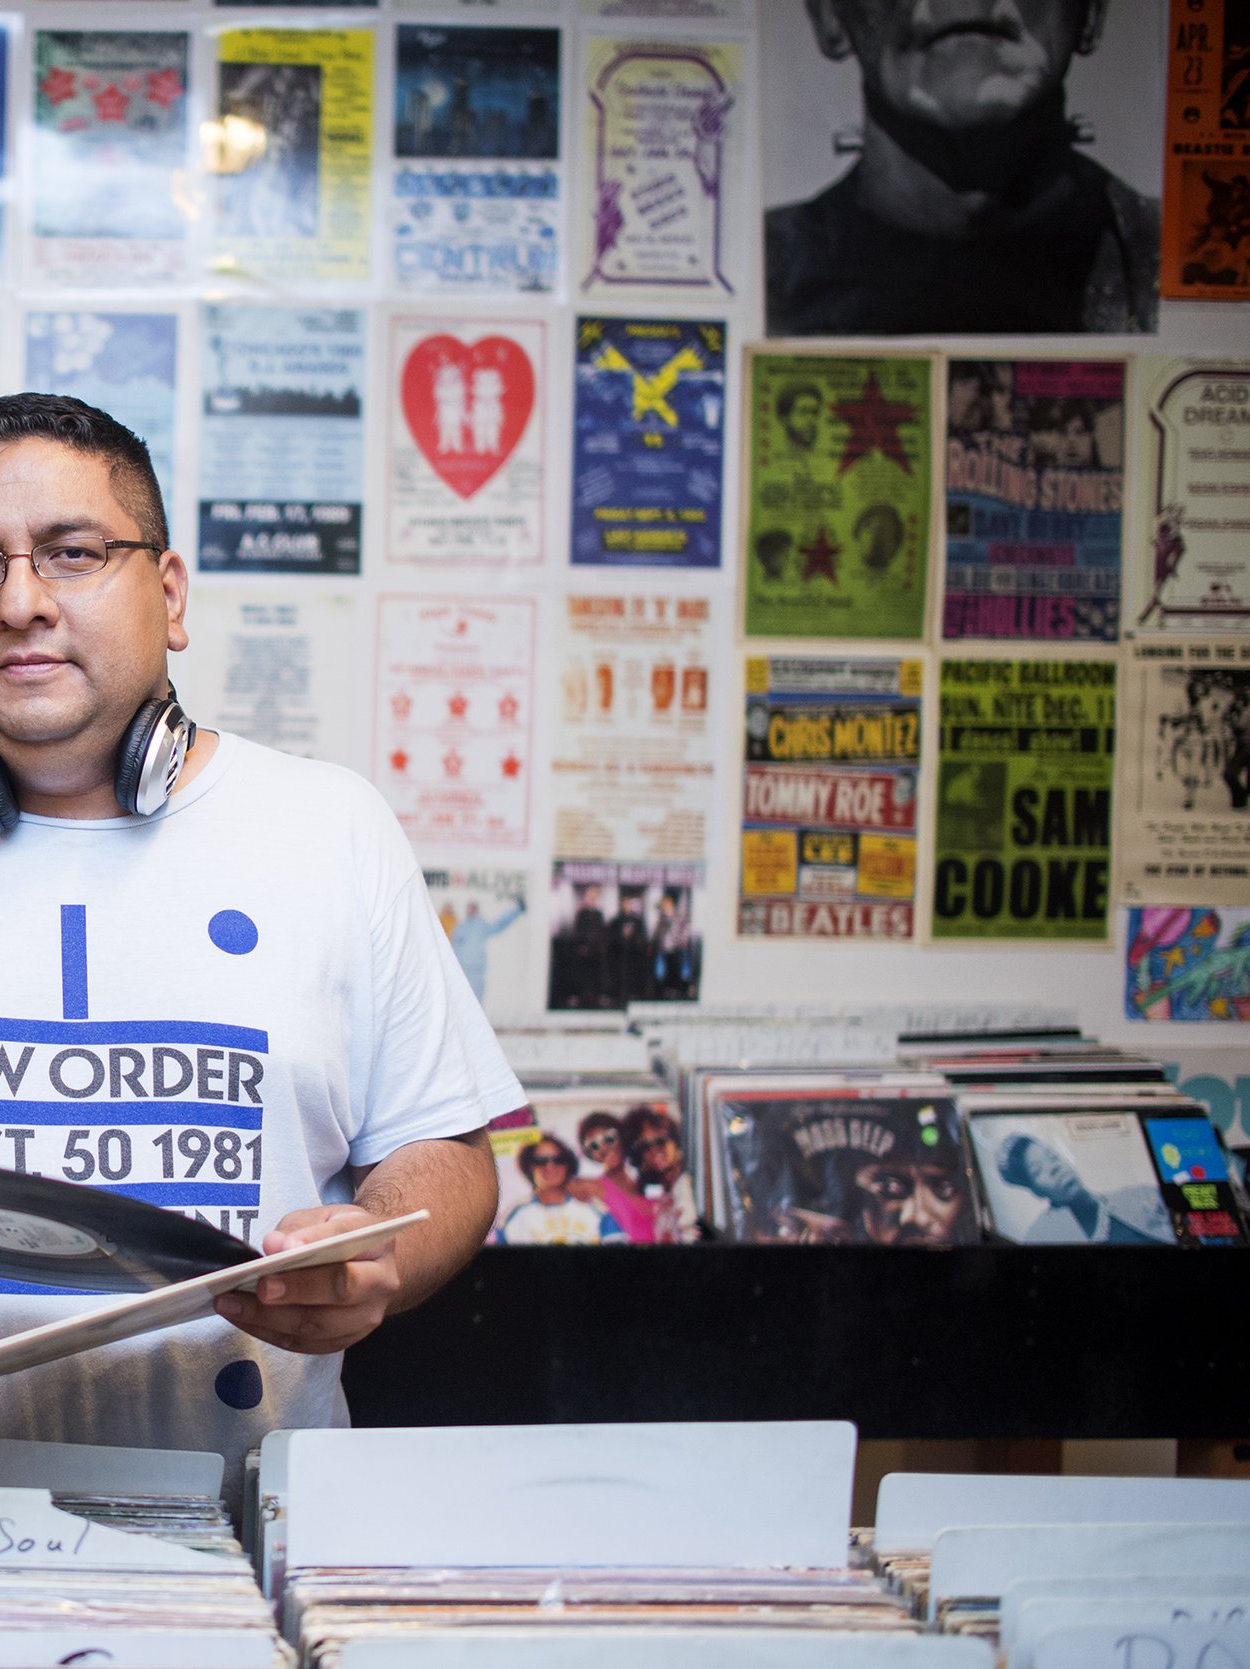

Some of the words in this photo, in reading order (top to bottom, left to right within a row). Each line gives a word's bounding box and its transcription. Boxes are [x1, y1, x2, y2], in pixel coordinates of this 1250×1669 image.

[1177, 24, 1212, 52] APR.
[1183, 56, 1204, 84] 23
[1173, 143, 1230, 156] BEASTIE
[1201, 386, 1249, 404] ACID
[948, 438, 1038, 512] ROLLING
[1040, 466, 1124, 514] STONES
[941, 661, 1012, 684] PACIFIC
[1019, 662, 1116, 687] BALLROOM
[940, 695, 986, 719] SUN.
[993, 694, 1037, 719] NITE
[1043, 694, 1090, 721] DEC.
[769, 712, 832, 760] CHRIS
[834, 710, 918, 760] MONTEZ
[745, 772, 831, 821] TOMMY
[833, 777, 883, 824] ROE
[1012, 788, 1109, 847] SAM
[466, 868, 527, 890] ALIVE
[935, 858, 1107, 920] COOKE
[770, 903, 910, 937] BEATLES
[49, 1047, 264, 1104] ORDER
[61, 1129, 132, 1181] 50
[151, 1128, 263, 1181] 1981
